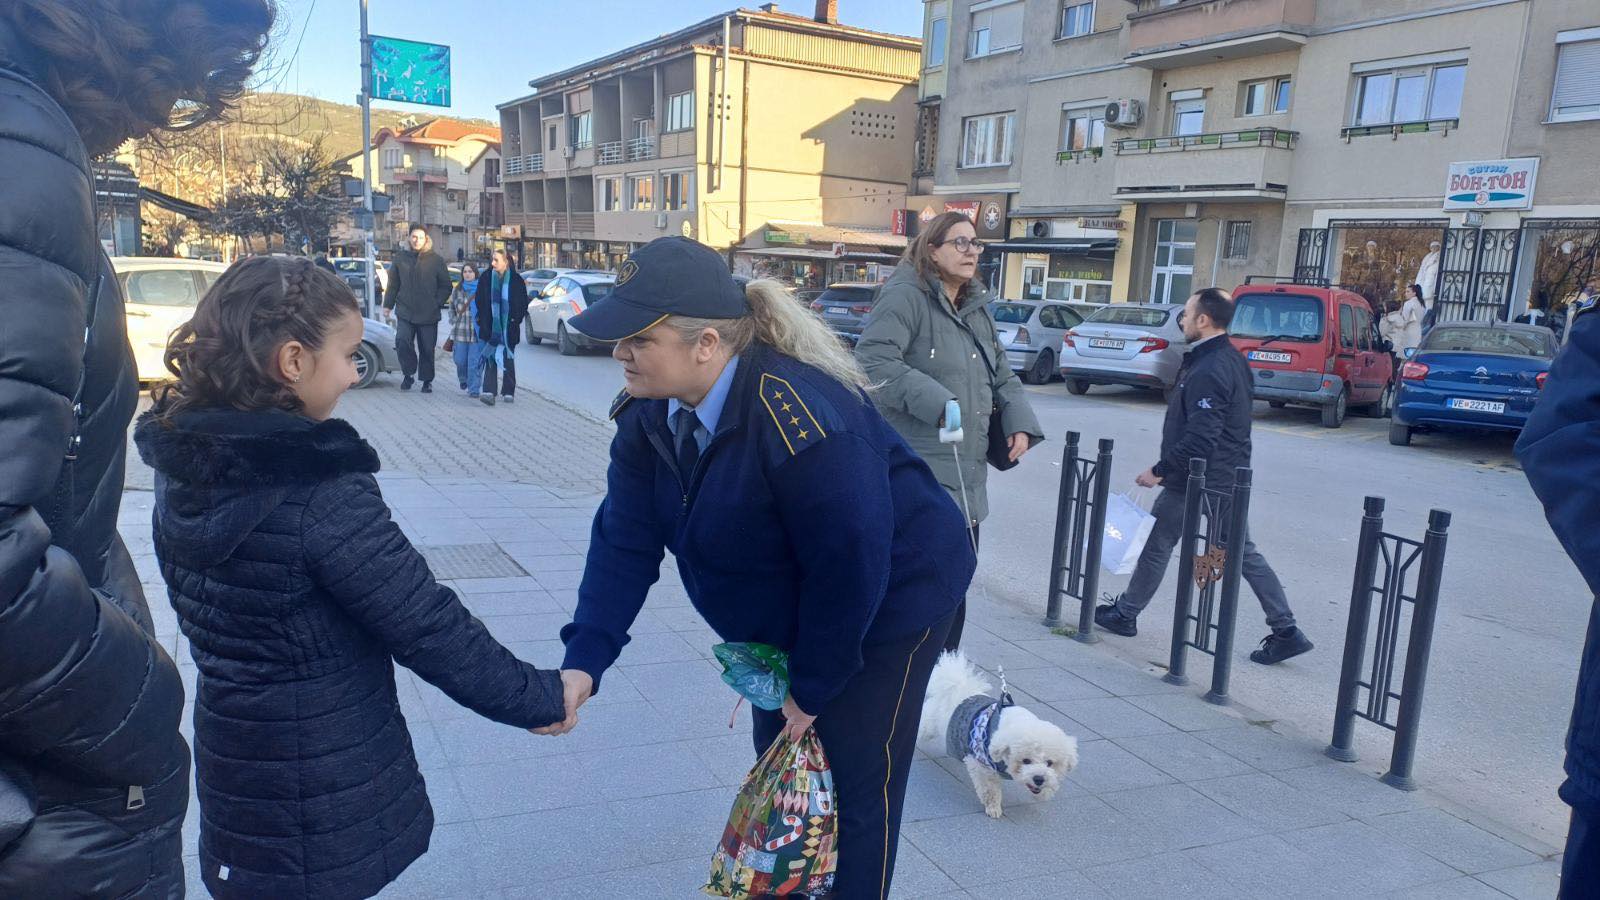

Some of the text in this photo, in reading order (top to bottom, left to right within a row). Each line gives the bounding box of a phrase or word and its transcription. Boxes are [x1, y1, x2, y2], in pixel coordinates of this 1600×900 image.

[1449, 170, 1528, 192] БОН-ТОН
[1453, 399, 1504, 412] VE 2221 AF
